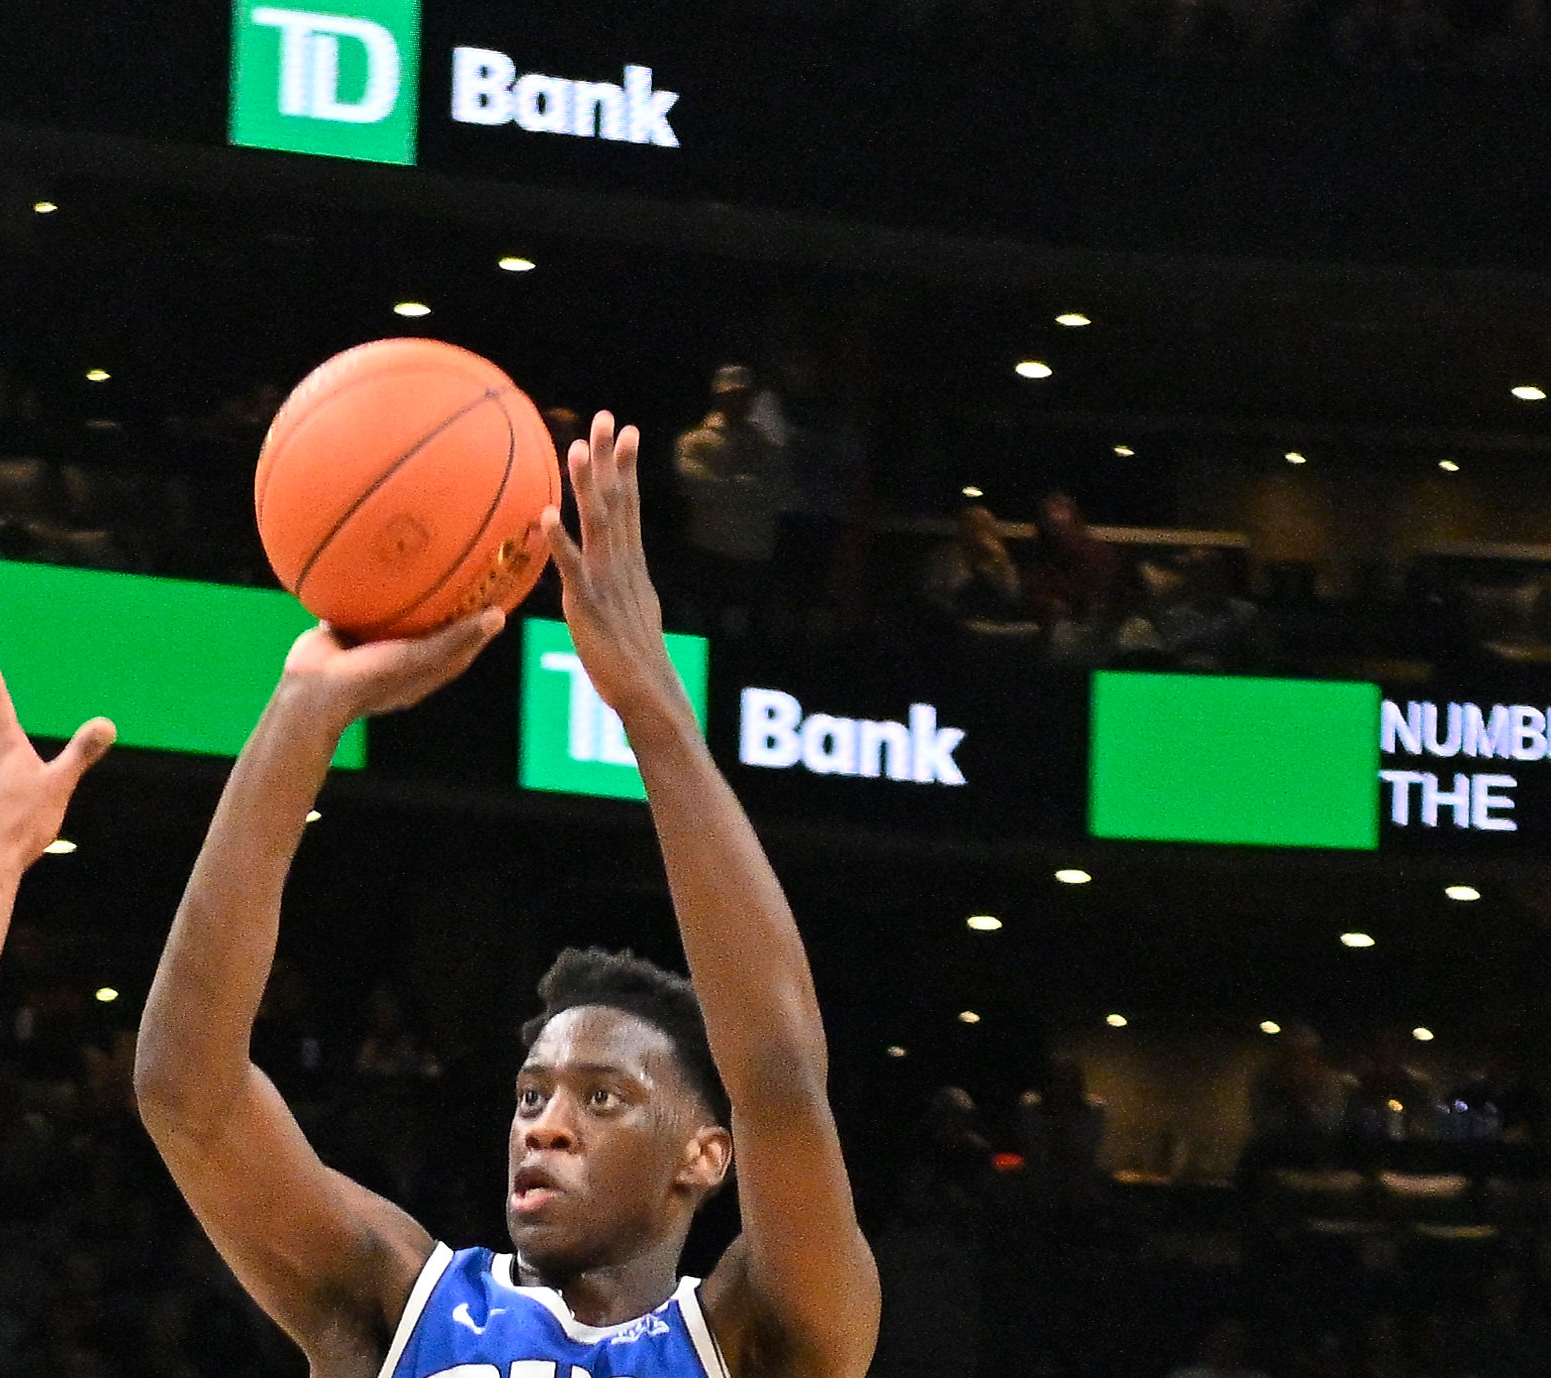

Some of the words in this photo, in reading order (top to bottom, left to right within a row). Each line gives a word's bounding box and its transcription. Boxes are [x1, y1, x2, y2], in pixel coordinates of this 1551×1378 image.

[251, 7, 400, 123] TD
[451, 46, 680, 148] Bank
[739, 687, 966, 786] Bank
[1380, 770, 1519, 831] THE
